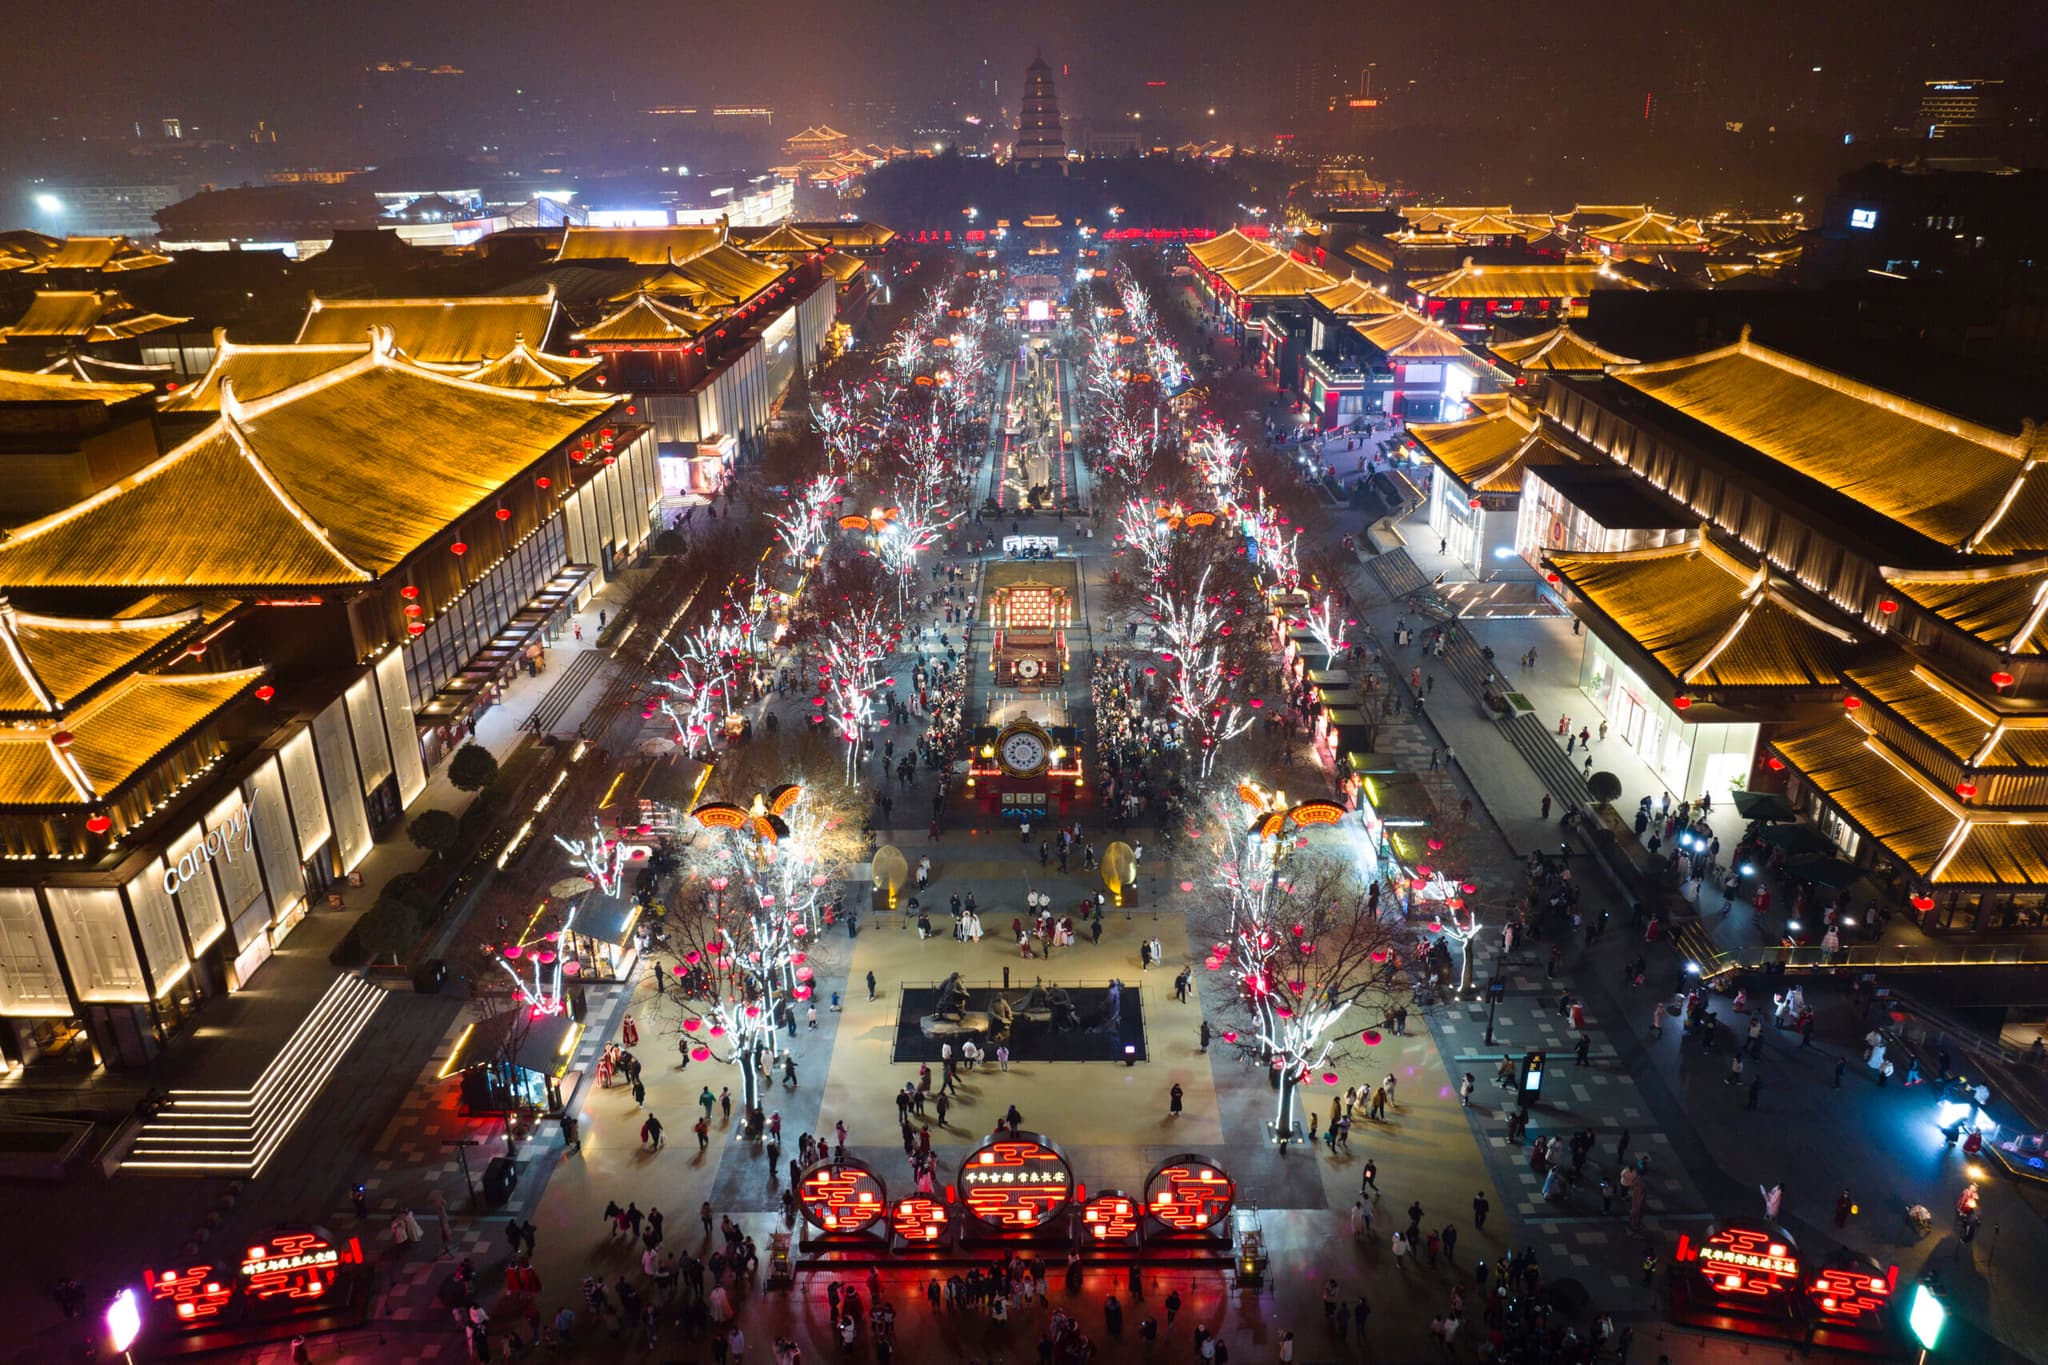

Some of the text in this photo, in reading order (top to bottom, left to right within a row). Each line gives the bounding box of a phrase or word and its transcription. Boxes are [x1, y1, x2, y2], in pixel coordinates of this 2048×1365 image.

[163, 787, 259, 895] canopy
[965, 1171, 1014, 1184] 千年古都
